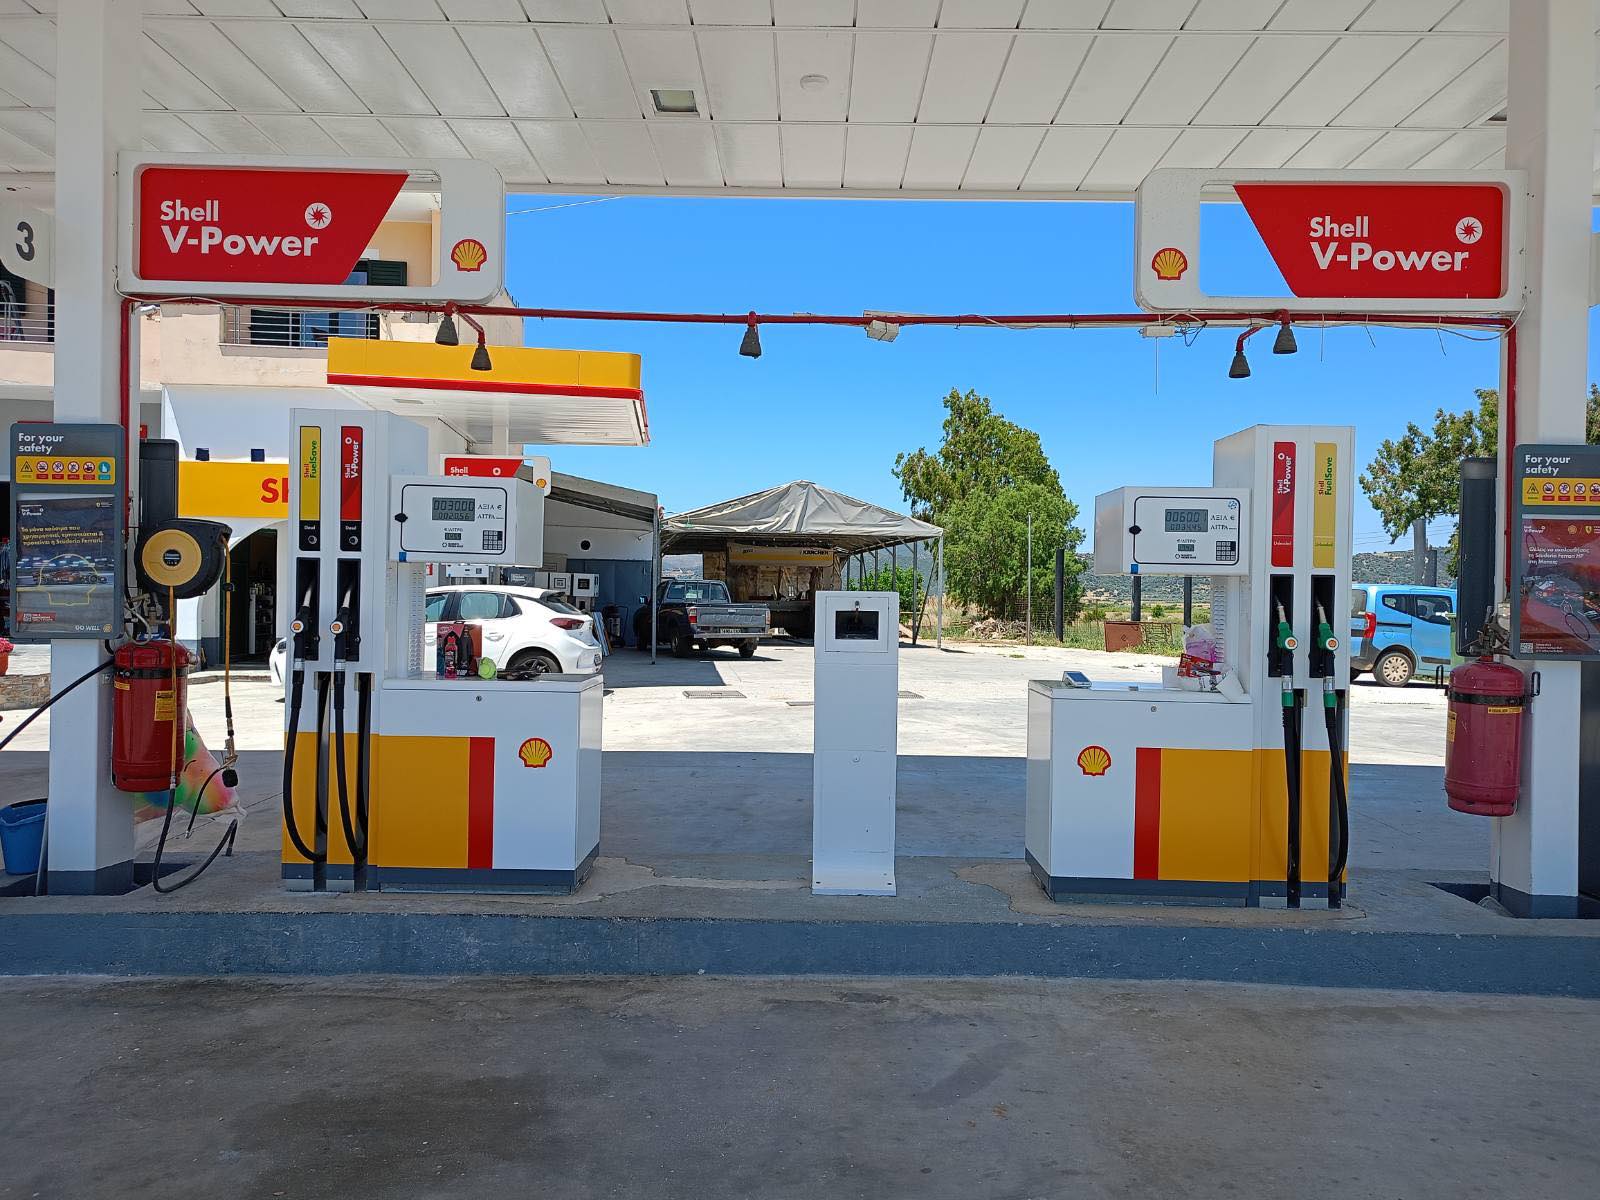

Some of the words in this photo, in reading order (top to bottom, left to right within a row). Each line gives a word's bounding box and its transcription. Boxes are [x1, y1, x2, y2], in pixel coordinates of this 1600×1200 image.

[160, 200, 219, 222] Shell
[1309, 216, 1369, 238] Shell
[15, 221, 35, 261] 3
[160, 226, 318, 257] V-Power
[1310, 242, 1469, 271] V-Power
[18, 443, 52, 454] safety
[19, 433, 36, 442] For
[38, 435, 64, 444] your
[309, 440, 318, 478] FuelSave
[350, 440, 359, 478] V-Power
[450, 466, 469, 474] Shell
[1525, 454, 1543, 463] For
[1545, 457, 1571, 465] your
[1525, 465, 1559, 476] safety
[1283, 455, 1292, 494] V-Power
[1324, 457, 1333, 495] FuelSave
